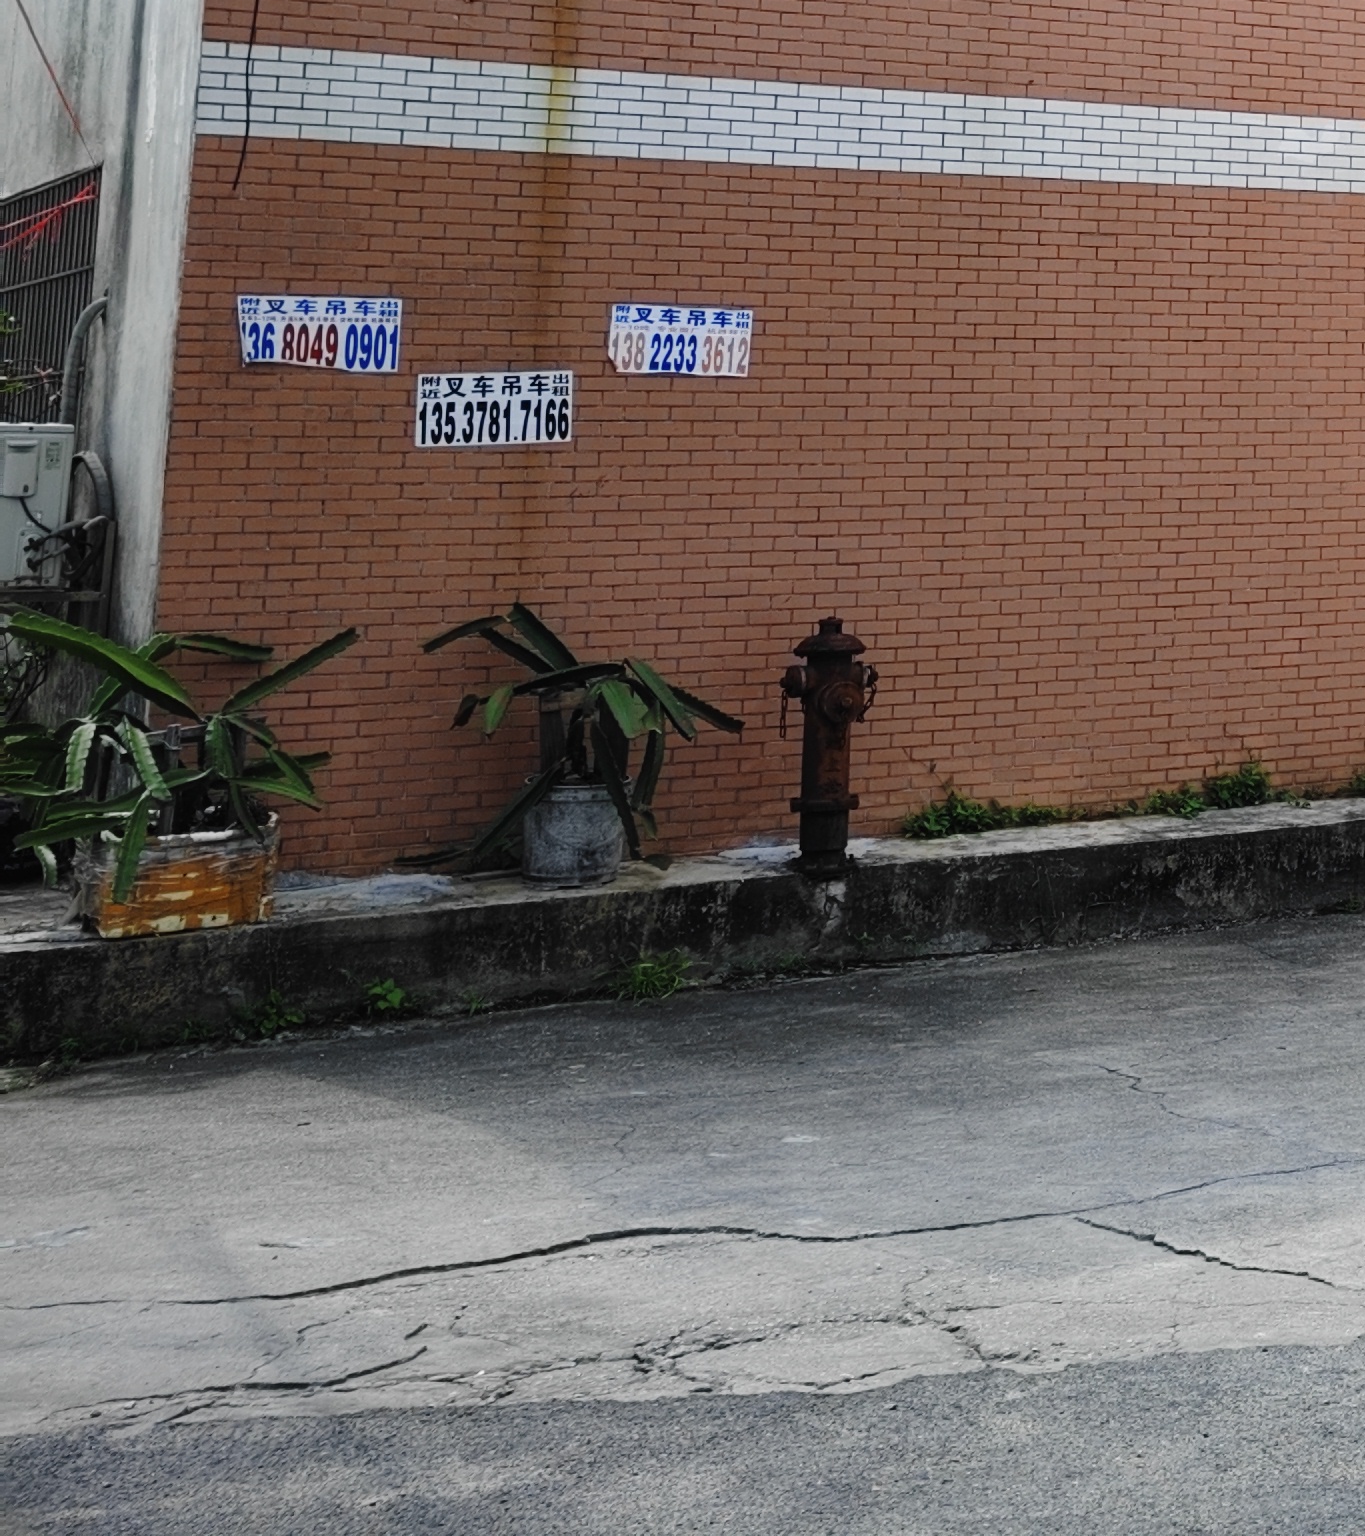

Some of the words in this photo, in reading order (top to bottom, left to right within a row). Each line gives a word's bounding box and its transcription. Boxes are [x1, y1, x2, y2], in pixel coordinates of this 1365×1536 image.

[263, 298, 377, 316] 叉车吊车
[379, 300, 399, 317] 出租
[632, 308, 733, 328] 叉车吊车
[735, 311, 750, 329] 出租
[281, 323, 339, 367] 8049
[345, 323, 398, 370] 0901
[612, 332, 645, 370] 138
[649, 333, 697, 372] 2233
[702, 335, 748, 374] 3612
[420, 376, 441, 399] 附近
[443, 374, 550, 398] 叉车吊车
[551, 373, 570, 396] 出租
[419, 398, 569, 445] 135.3781.7166
